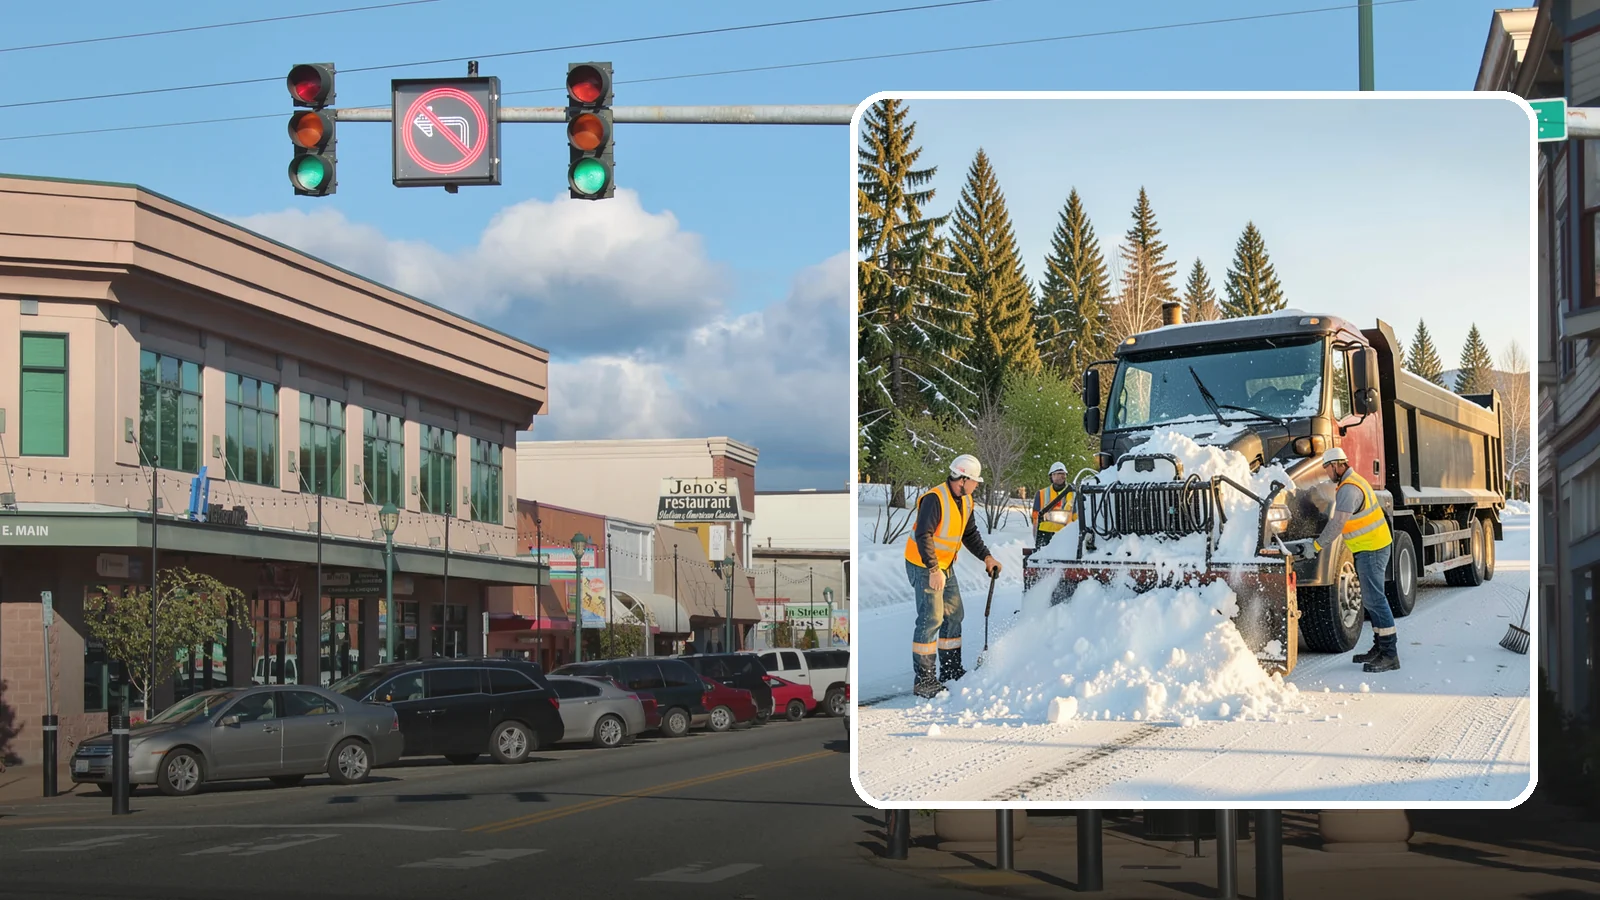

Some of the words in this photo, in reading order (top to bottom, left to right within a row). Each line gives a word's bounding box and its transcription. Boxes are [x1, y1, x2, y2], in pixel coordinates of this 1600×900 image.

[670, 480, 728, 494] Jeno's
[665, 497, 731, 509] restaurant
[686, 510, 715, 519] American
[715, 510, 737, 519] Cuisine
[2, 525, 13, 536] E.
[15, 525, 49, 536] MAIN
[797, 607, 828, 617] Street
